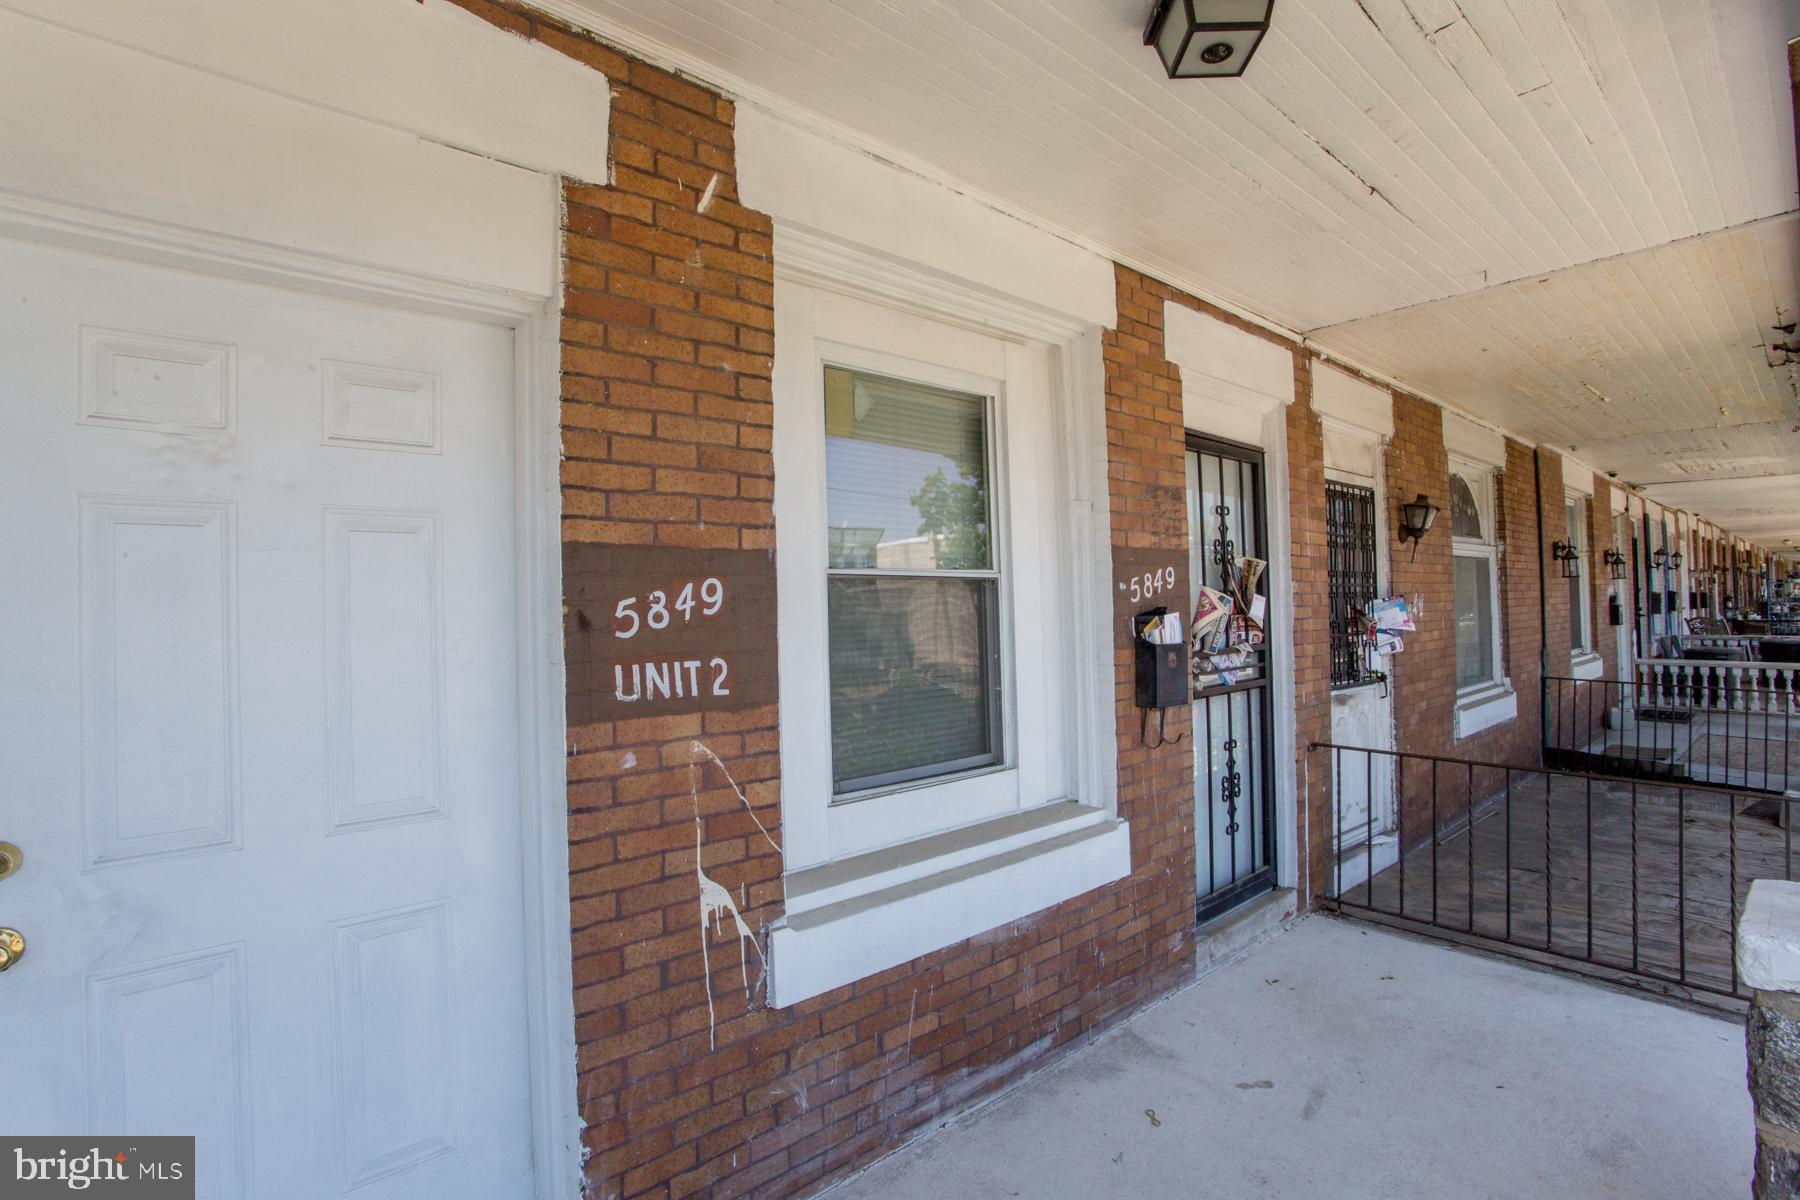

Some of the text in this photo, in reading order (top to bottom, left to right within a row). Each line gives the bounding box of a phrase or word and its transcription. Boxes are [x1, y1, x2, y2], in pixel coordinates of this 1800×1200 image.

[1130, 566, 1175, 603] 5849
[614, 577, 724, 639] 5849
[614, 657, 730, 702] UNIT 2
